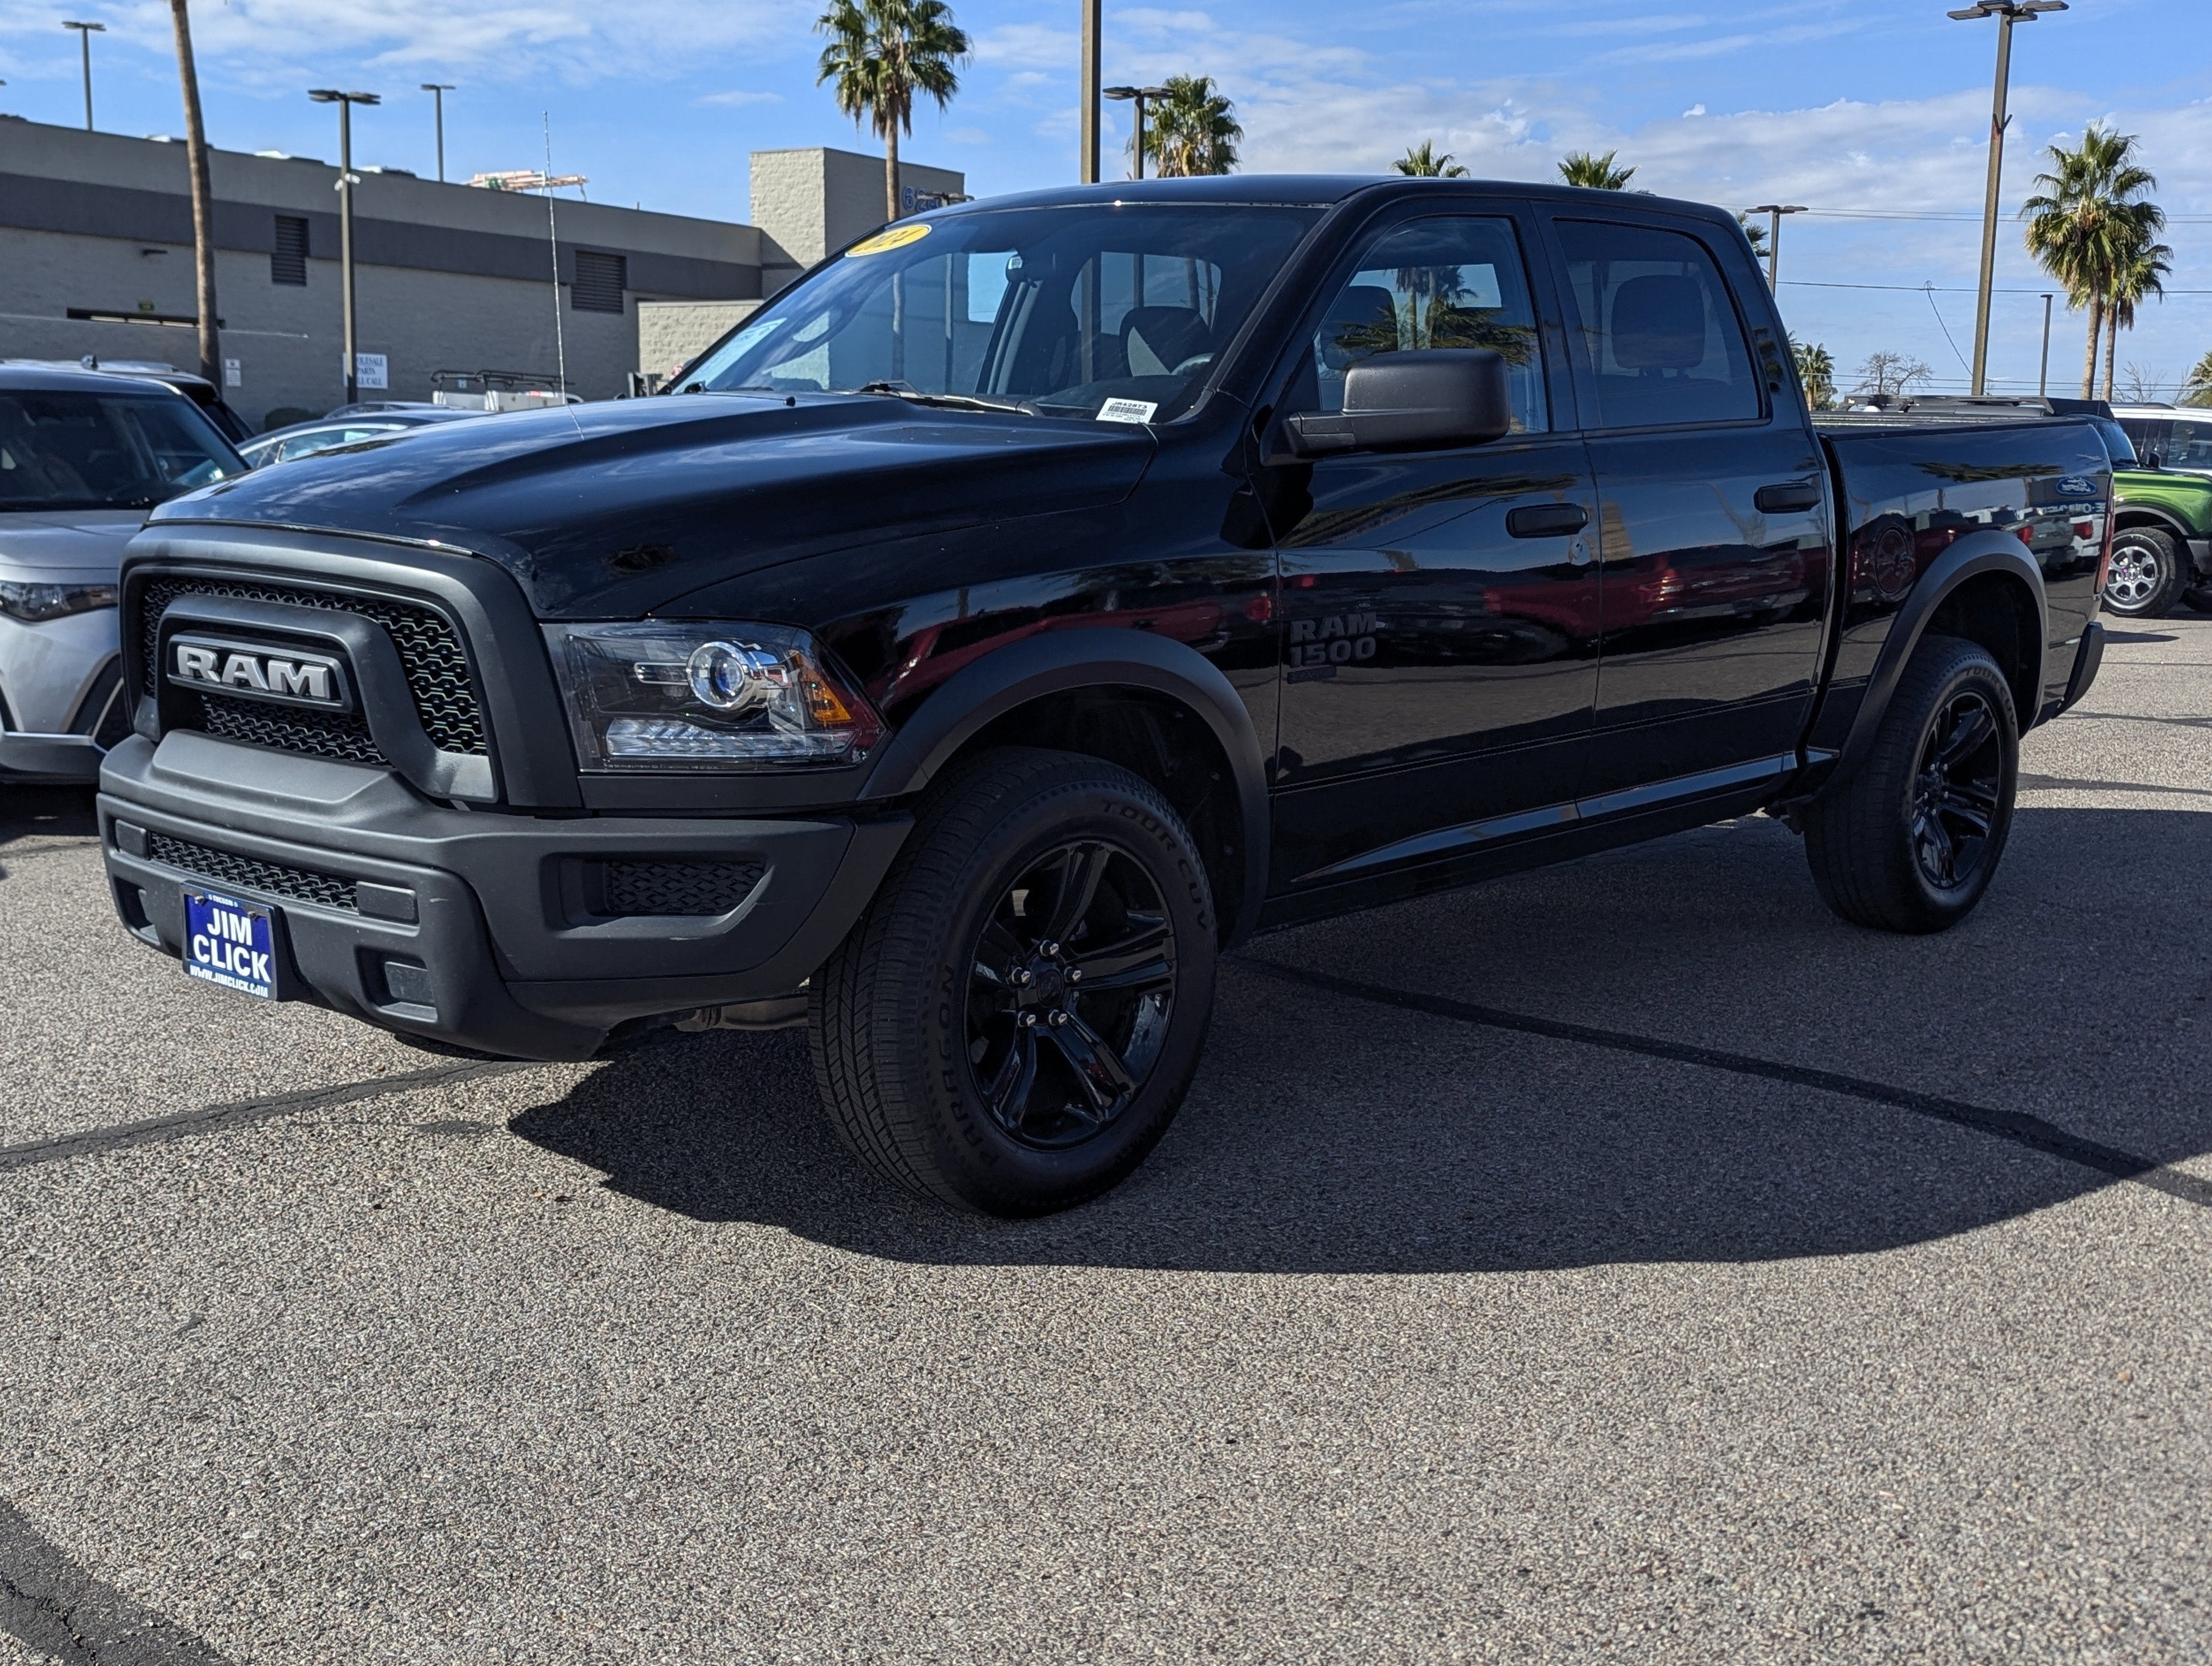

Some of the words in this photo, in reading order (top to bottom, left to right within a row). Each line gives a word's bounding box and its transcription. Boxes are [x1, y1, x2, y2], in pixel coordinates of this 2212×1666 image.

[357, 356, 383, 366] OLESALE
[1290, 612, 1377, 644] RAM
[1289, 637, 1377, 668] 1500
[177, 645, 331, 700] RAM
[1102, 799, 1178, 851] TOUR
[1177, 858, 1208, 931] CUV
[207, 908, 253, 946] JIM
[193, 934, 272, 983] CLICK
